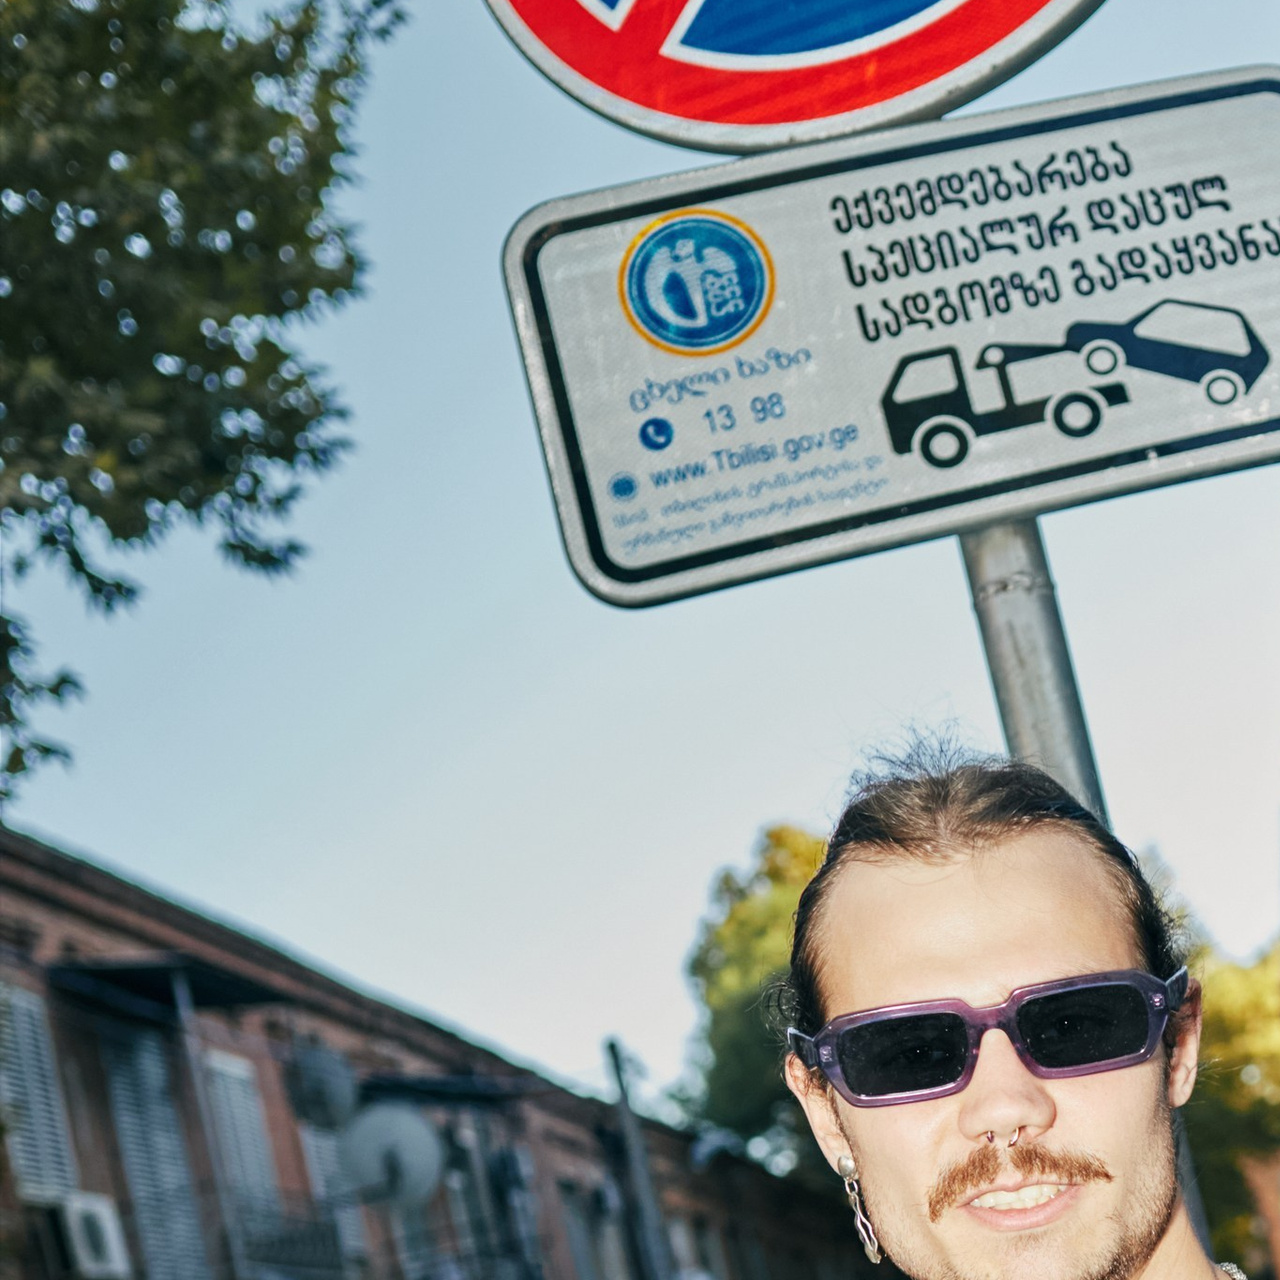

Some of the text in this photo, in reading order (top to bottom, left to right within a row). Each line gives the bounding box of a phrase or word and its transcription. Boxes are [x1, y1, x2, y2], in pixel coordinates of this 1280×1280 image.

[829, 141, 1133, 234] ექვემდებარება
[842, 174, 1232, 287] სპეციალურ დაცულ
[854, 265, 1060, 342] სადგომზე
[629, 347, 813, 414] ცხელი ხაზი
[702, 392, 786, 434] 13 98
